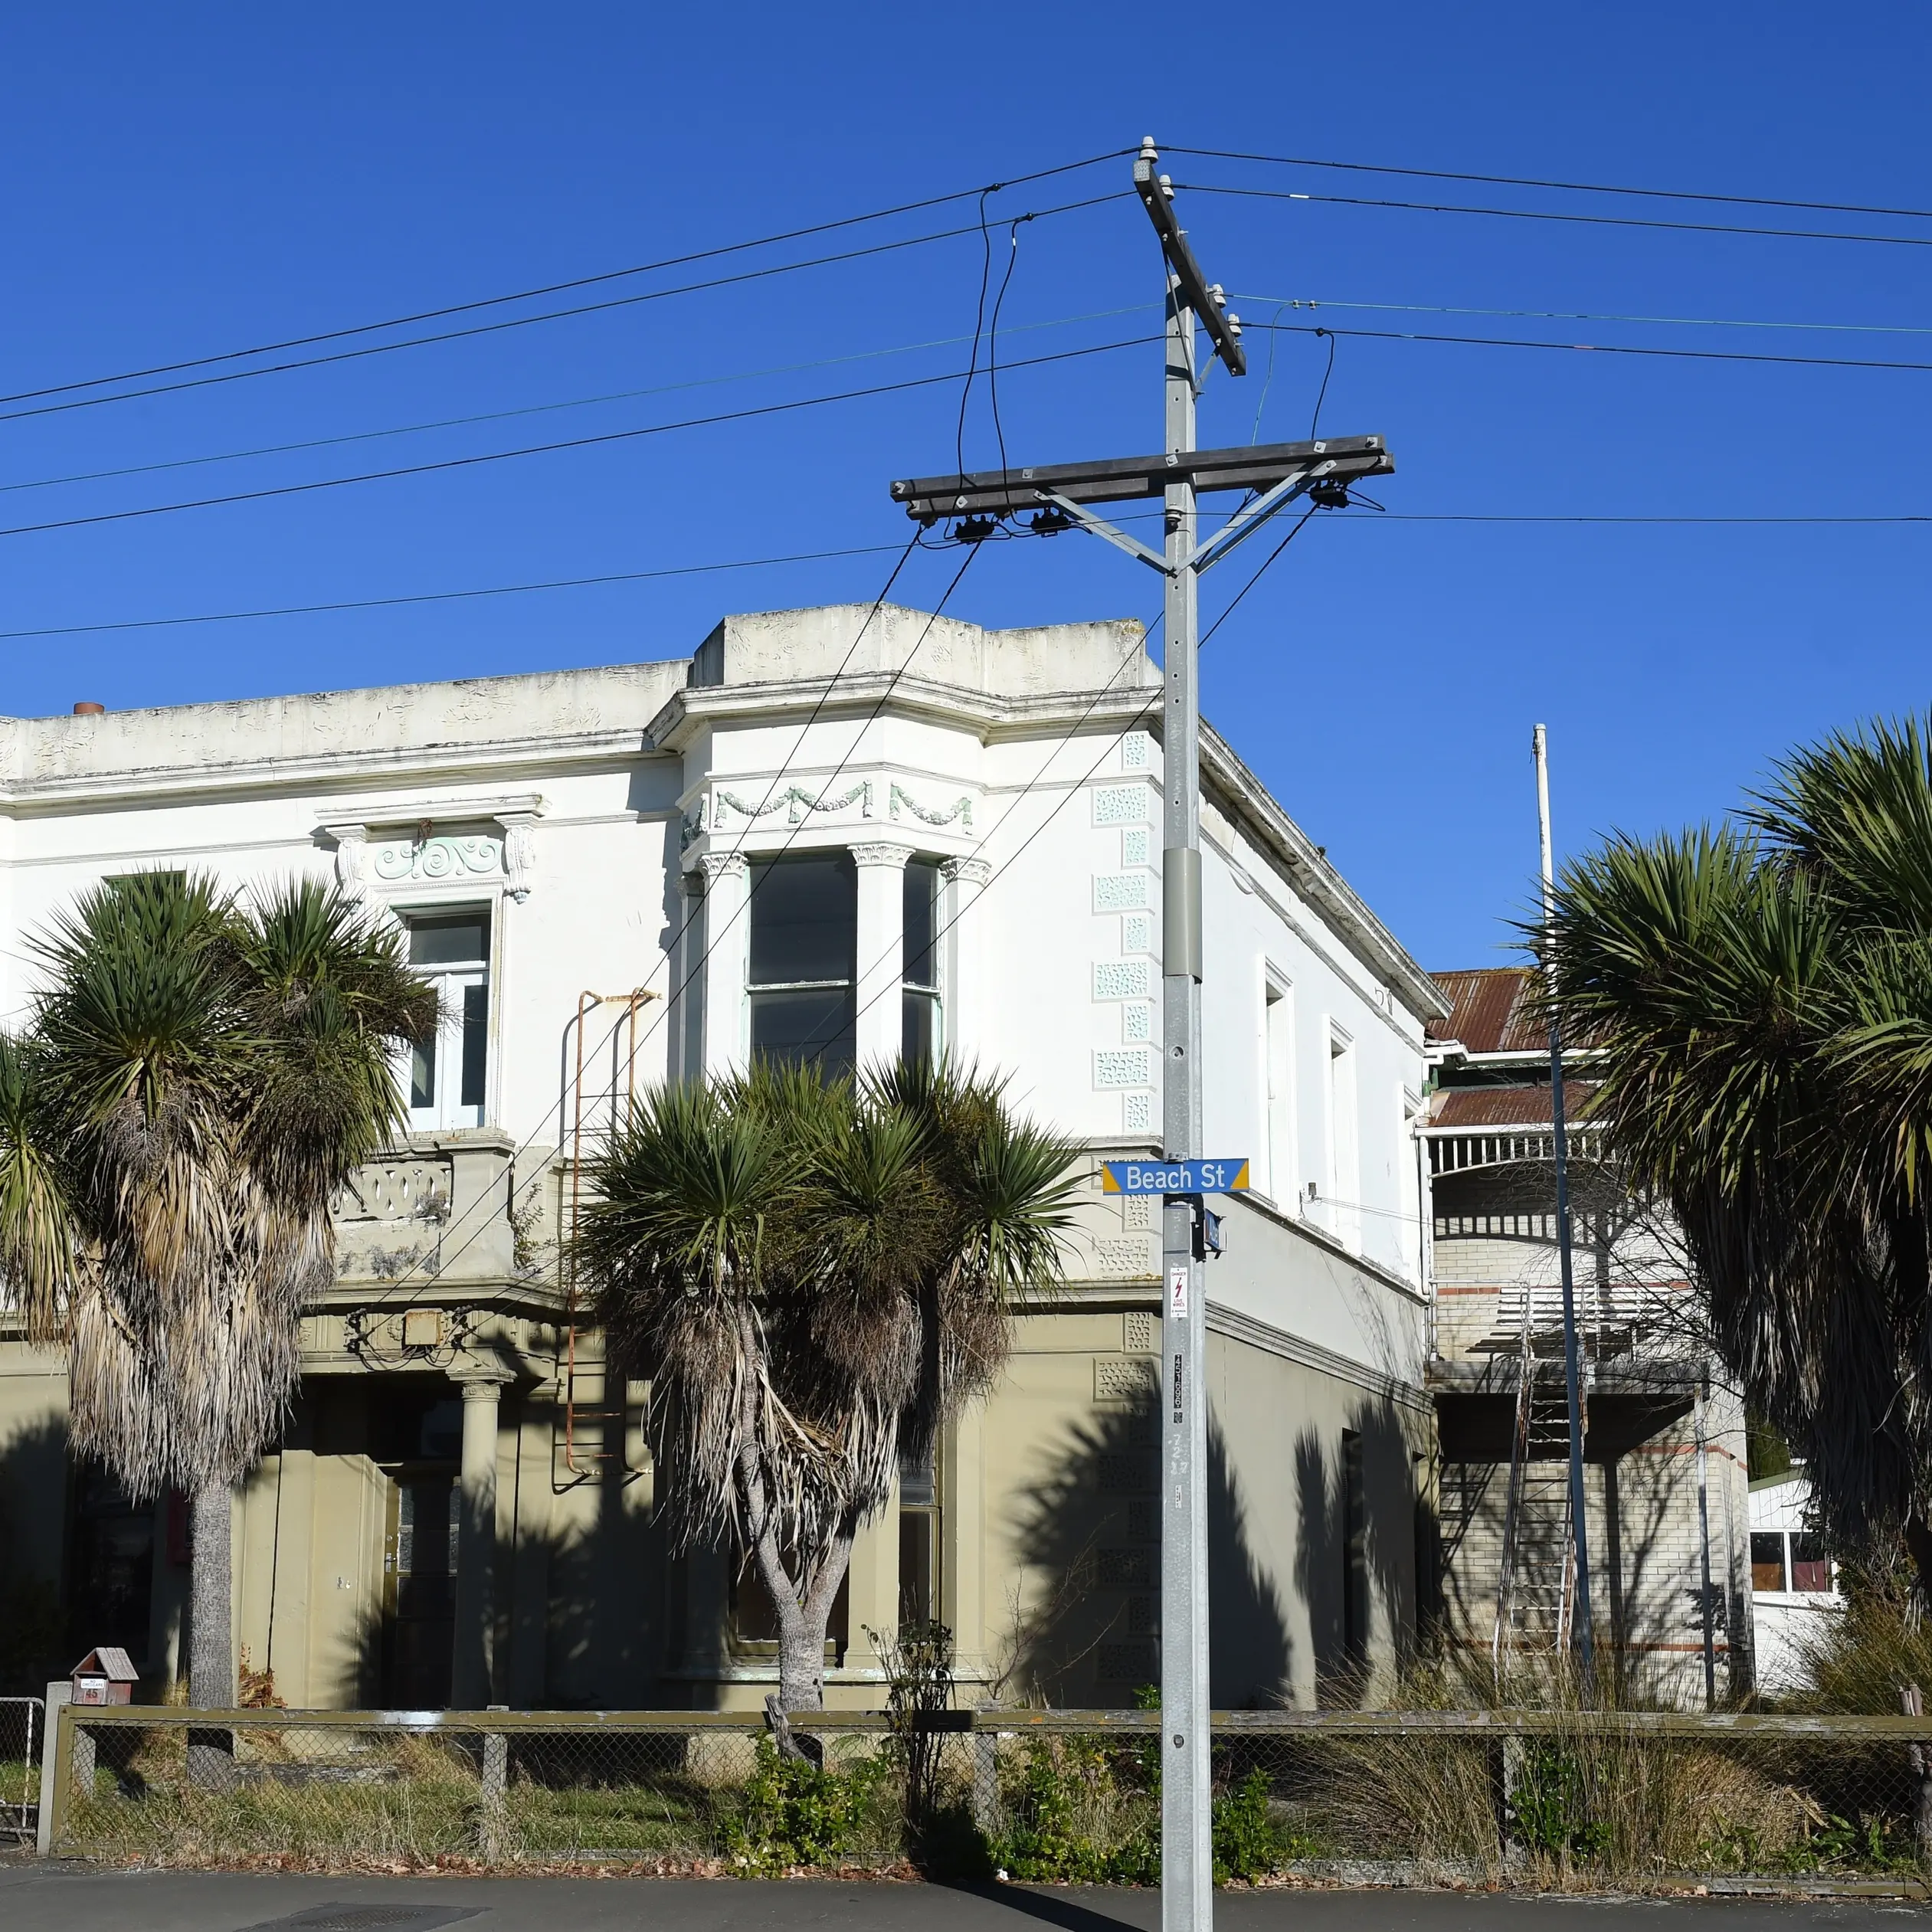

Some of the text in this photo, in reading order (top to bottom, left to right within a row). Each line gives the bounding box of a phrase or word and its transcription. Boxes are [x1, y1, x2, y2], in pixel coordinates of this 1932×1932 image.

[1127, 1164, 1225, 1189] Beach St
[86, 1689, 98, 1698] 45
